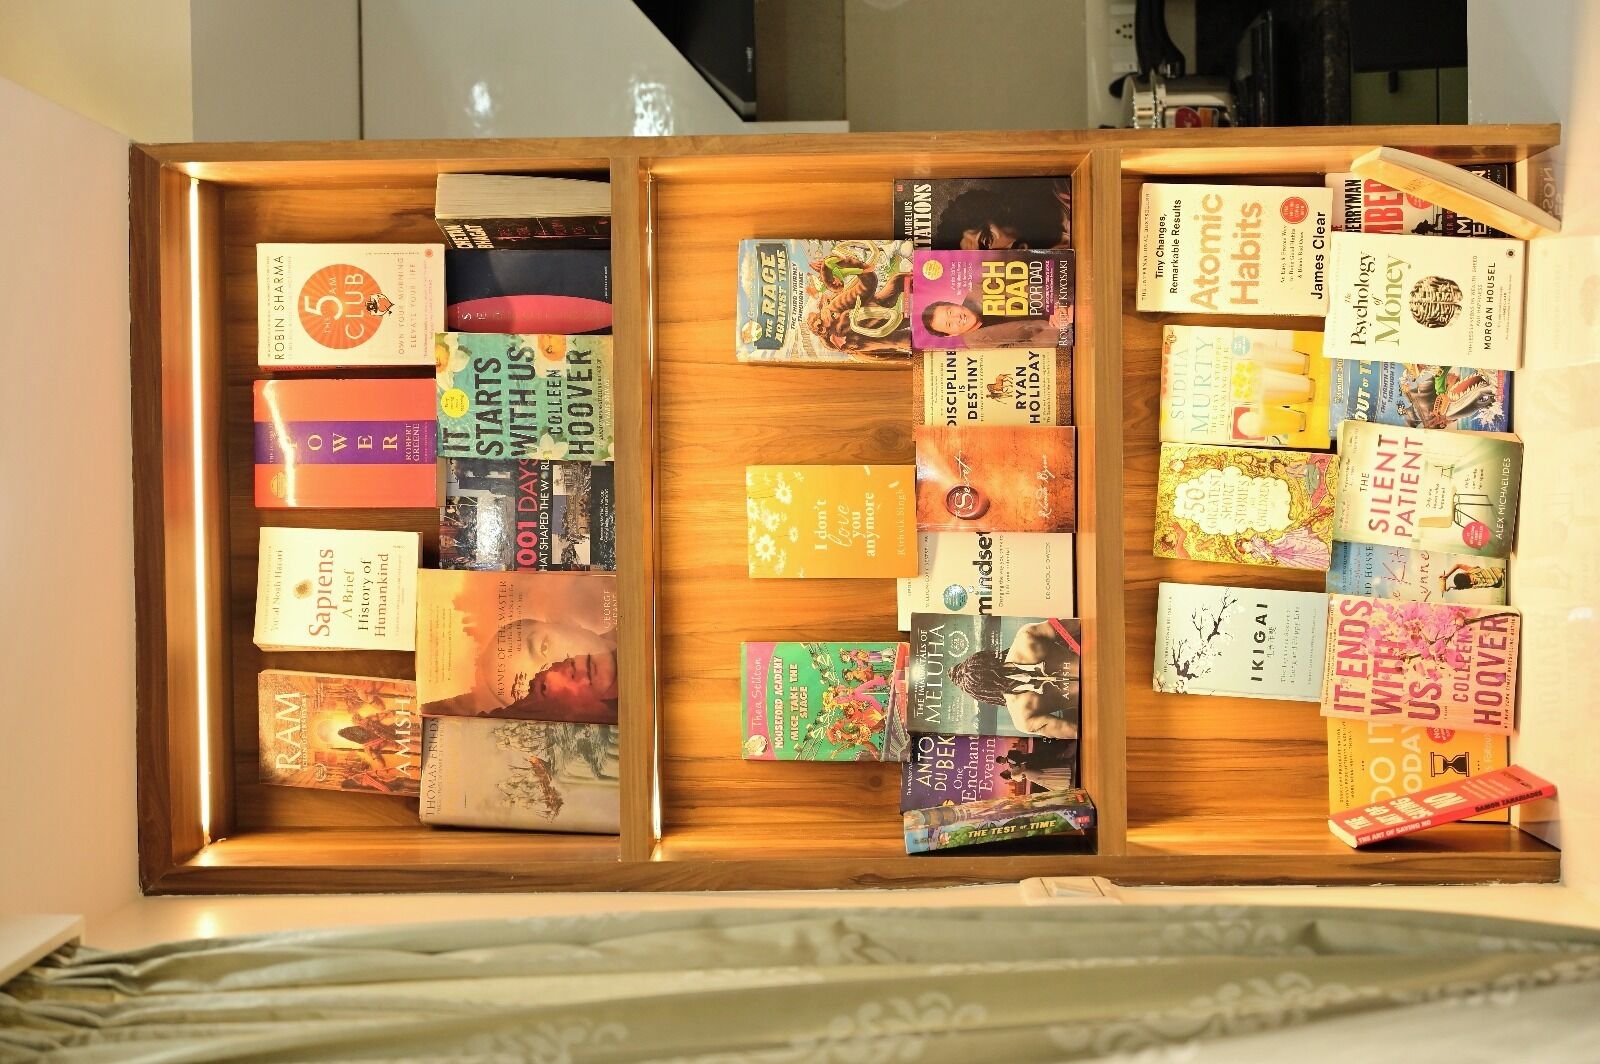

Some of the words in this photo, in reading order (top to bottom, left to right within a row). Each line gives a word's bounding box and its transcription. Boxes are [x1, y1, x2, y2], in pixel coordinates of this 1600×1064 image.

[443, 224, 473, 249] CHETAN
[463, 224, 495, 249] BHAGAT
[905, 201, 913, 236] AURELIUS
[1156, 213, 1167, 258] Changes,
[1171, 199, 1182, 236] Results
[1312, 211, 1326, 250] Clear
[776, 249, 787, 282] TIME
[1155, 260, 1165, 279] Tiny
[1170, 238, 1180, 294] Remarkable
[1190, 193, 1223, 311] Atomic
[1230, 201, 1262, 305] Habits
[273, 255, 285, 311] SHARMA
[328, 275, 336, 295] AM
[397, 257, 405, 300] MORNING
[760, 251, 777, 317] RACE
[982, 261, 1006, 315] RICH
[1005, 260, 1029, 316] DAD
[1029, 261, 1043, 284] DAD
[1058, 259, 1069, 300] KIYOSAKI
[1310, 253, 1325, 300] James
[1486, 262, 1496, 303] HOUSEL
[304, 295, 343, 321] 5
[344, 272, 365, 340] CLUB
[774, 286, 787, 344] AGAINST
[1029, 285, 1044, 316] POOR
[1350, 251, 1376, 346] Psychology
[1371, 293, 1384, 306] of
[1374, 254, 1412, 346] Money
[274, 317, 286, 360] ROBIN
[323, 316, 333, 334] THE
[765, 318, 773, 338] THE
[1058, 307, 1069, 346] ROBERT
[1484, 307, 1493, 350] MORGAN
[507, 344, 537, 381] US
[1362, 377, 1369, 388] OF
[546, 368, 563, 436] COLLEEN
[566, 349, 595, 455] HOOVER
[947, 351, 957, 426] DISCIPLINE
[959, 384, 966, 393] IS
[967, 356, 978, 420] DESTINY
[1016, 365, 1027, 409] RYAN
[1028, 350, 1041, 424] HOLIDAY
[1170, 348, 1188, 420] SUDHA
[1190, 335, 1214, 434] MURTY
[1354, 386, 1371, 421] OUT
[1388, 371, 1396, 402] THROUGH
[474, 356, 504, 457] STARTS
[508, 387, 537, 457] WITH
[405, 423, 413, 461] ROBERT
[412, 423, 420, 462] GREENE
[442, 427, 470, 453] IT
[518, 458, 539, 512] DAYS
[953, 450, 974, 510] Secret
[1183, 487, 1205, 513] 50
[1360, 472, 1369, 492] THE
[1367, 434, 1399, 533] SILENT
[1394, 436, 1424, 538] PATIENT
[1498, 457, 1511, 515] MICHAELIDES
[541, 493, 550, 510] THE
[814, 499, 828, 540] don't
[896, 489, 906, 515] Singh
[1206, 473, 1222, 529] GREATEST
[1220, 481, 1234, 520] SHORT
[1234, 479, 1249, 524] STORIES
[1258, 481, 1270, 527] CHILDREN
[540, 511, 550, 550] SHAPED
[827, 503, 853, 547] love
[851, 510, 866, 538] you
[865, 491, 880, 557] anymore
[1495, 517, 1505, 540] ALEX
[517, 520, 538, 572] 1001
[540, 552, 549, 571] HAT
[1364, 545, 1373, 578] HOSSE
[343, 569, 355, 603] Brief
[361, 559, 372, 574] of
[972, 530, 993, 616] mindset
[1381, 548, 1411, 586] Kit
[272, 581, 282, 605] Noah
[308, 548, 337, 637] Sapiens
[358, 577, 374, 631] History
[374, 552, 389, 637] Humankind
[498, 580, 508, 620] MASTER
[603, 589, 611, 629] GEORGE
[342, 608, 353, 618] A
[497, 648, 506, 660] OF
[498, 625, 506, 643] THE
[920, 628, 928, 642] OF
[1250, 602, 1269, 682] IKIGAI
[1335, 599, 1373, 679] ENDS
[497, 665, 506, 696] BONES
[751, 657, 763, 698] Stilton
[773, 656, 784, 696] ACADEMY
[789, 663, 798, 683] THE
[918, 643, 928, 696] IMMORTALS
[924, 622, 946, 724] MELUHA
[1062, 661, 1071, 700] AMISH
[1370, 639, 1407, 716] WITH
[1452, 634, 1473, 703] COLLEEN
[1473, 617, 1508, 726] HOOVER
[752, 702, 763, 730] Thea
[790, 686, 799, 712] TAKE
[799, 685, 808, 719] STAGE
[917, 698, 925, 717] THE
[1333, 684, 1366, 713] IT
[1407, 680, 1442, 721] US
[275, 691, 303, 770] RAM
[395, 697, 413, 776] AMISH
[774, 698, 784, 748] MOUSEFORD
[790, 715, 799, 741] MICE
[915, 736, 936, 788] ANTO
[936, 735, 956, 770] BEK
[960, 735, 980, 803] Enchant
[977, 736, 996, 792] Evenin
[426, 763, 438, 816] THOMAS
[934, 772, 947, 792] DU
[953, 767, 964, 790] One
[1388, 796, 1435, 819] SAYING
[1422, 792, 1468, 809] NO
[1475, 801, 1500, 813] DAMON
[968, 828, 988, 838] THE
[991, 825, 1017, 835] TEST
[1029, 820, 1057, 830] TIME
[1358, 835, 1371, 843] THE
[1372, 831, 1385, 839] ART
[1395, 822, 1421, 833] SAYING
[1421, 819, 1432, 827] NO
